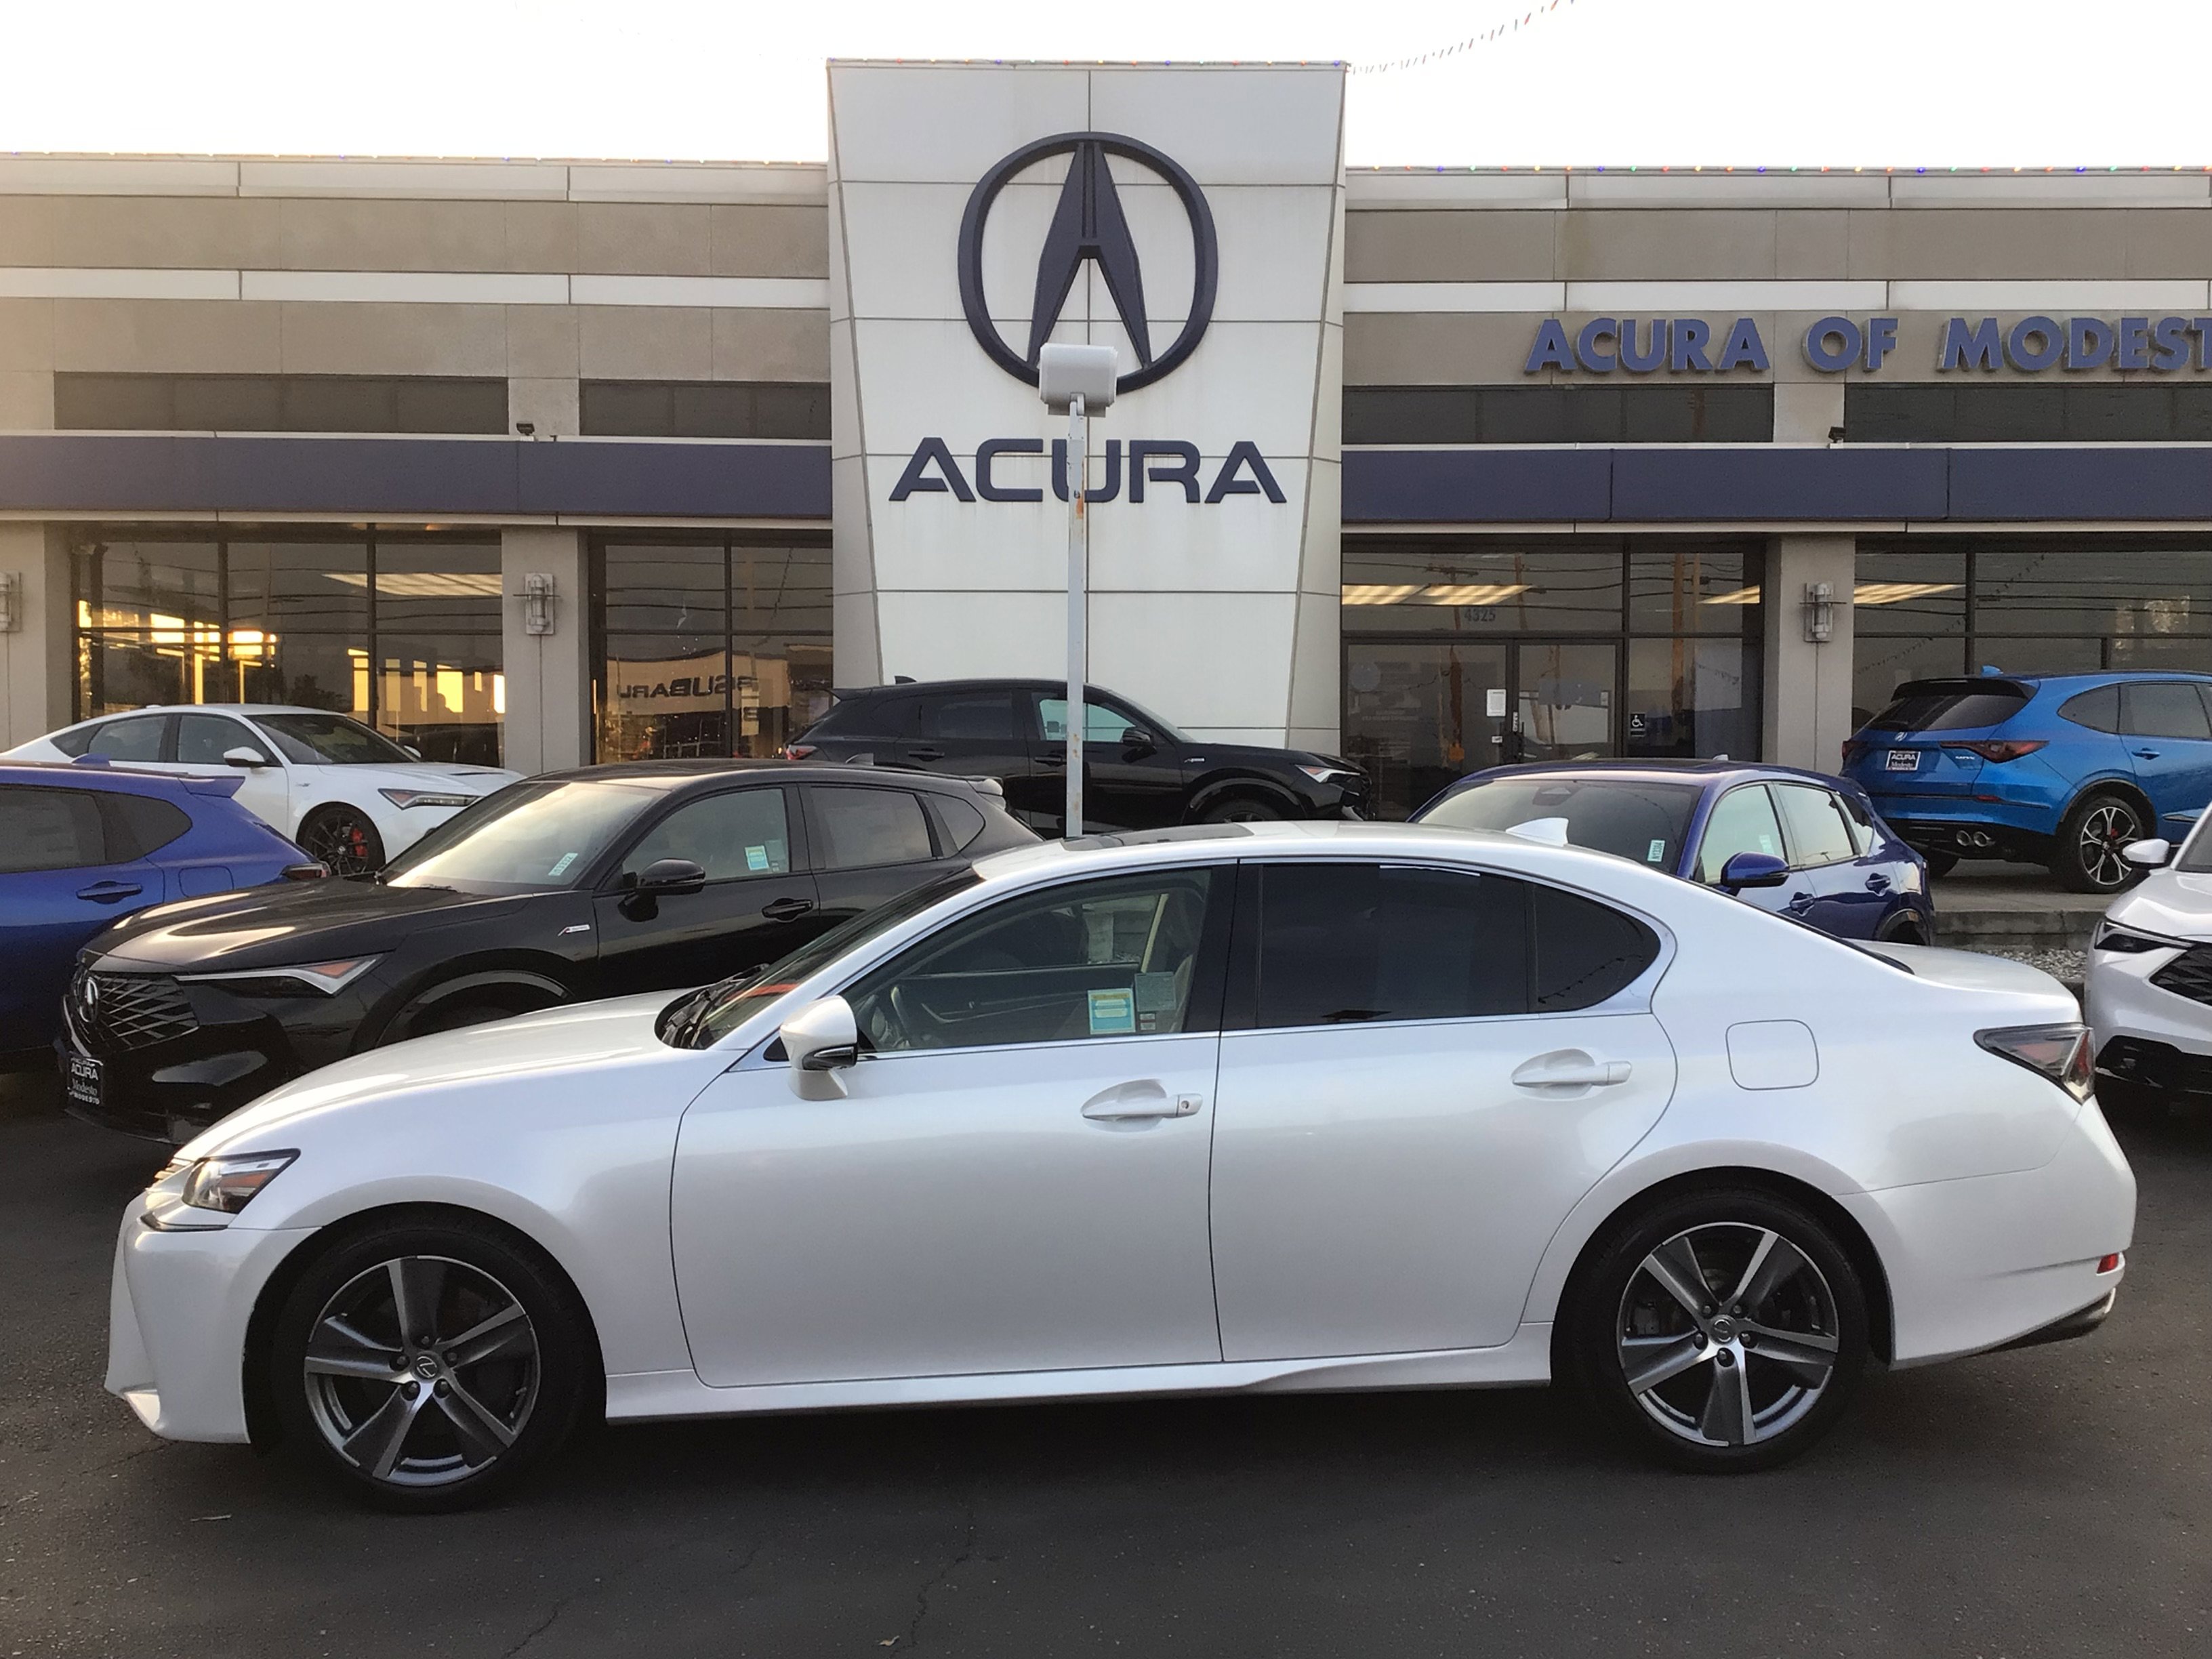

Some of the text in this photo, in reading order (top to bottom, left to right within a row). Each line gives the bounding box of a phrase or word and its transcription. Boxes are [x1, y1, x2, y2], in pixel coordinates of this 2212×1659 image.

[1525, 317, 1771, 373] ACURA
[1802, 316, 1897, 372] OF
[888, 437, 1287, 503] ACURA
[1465, 609, 1496, 621] 4325
[71, 1062, 98, 1080] ACURA
